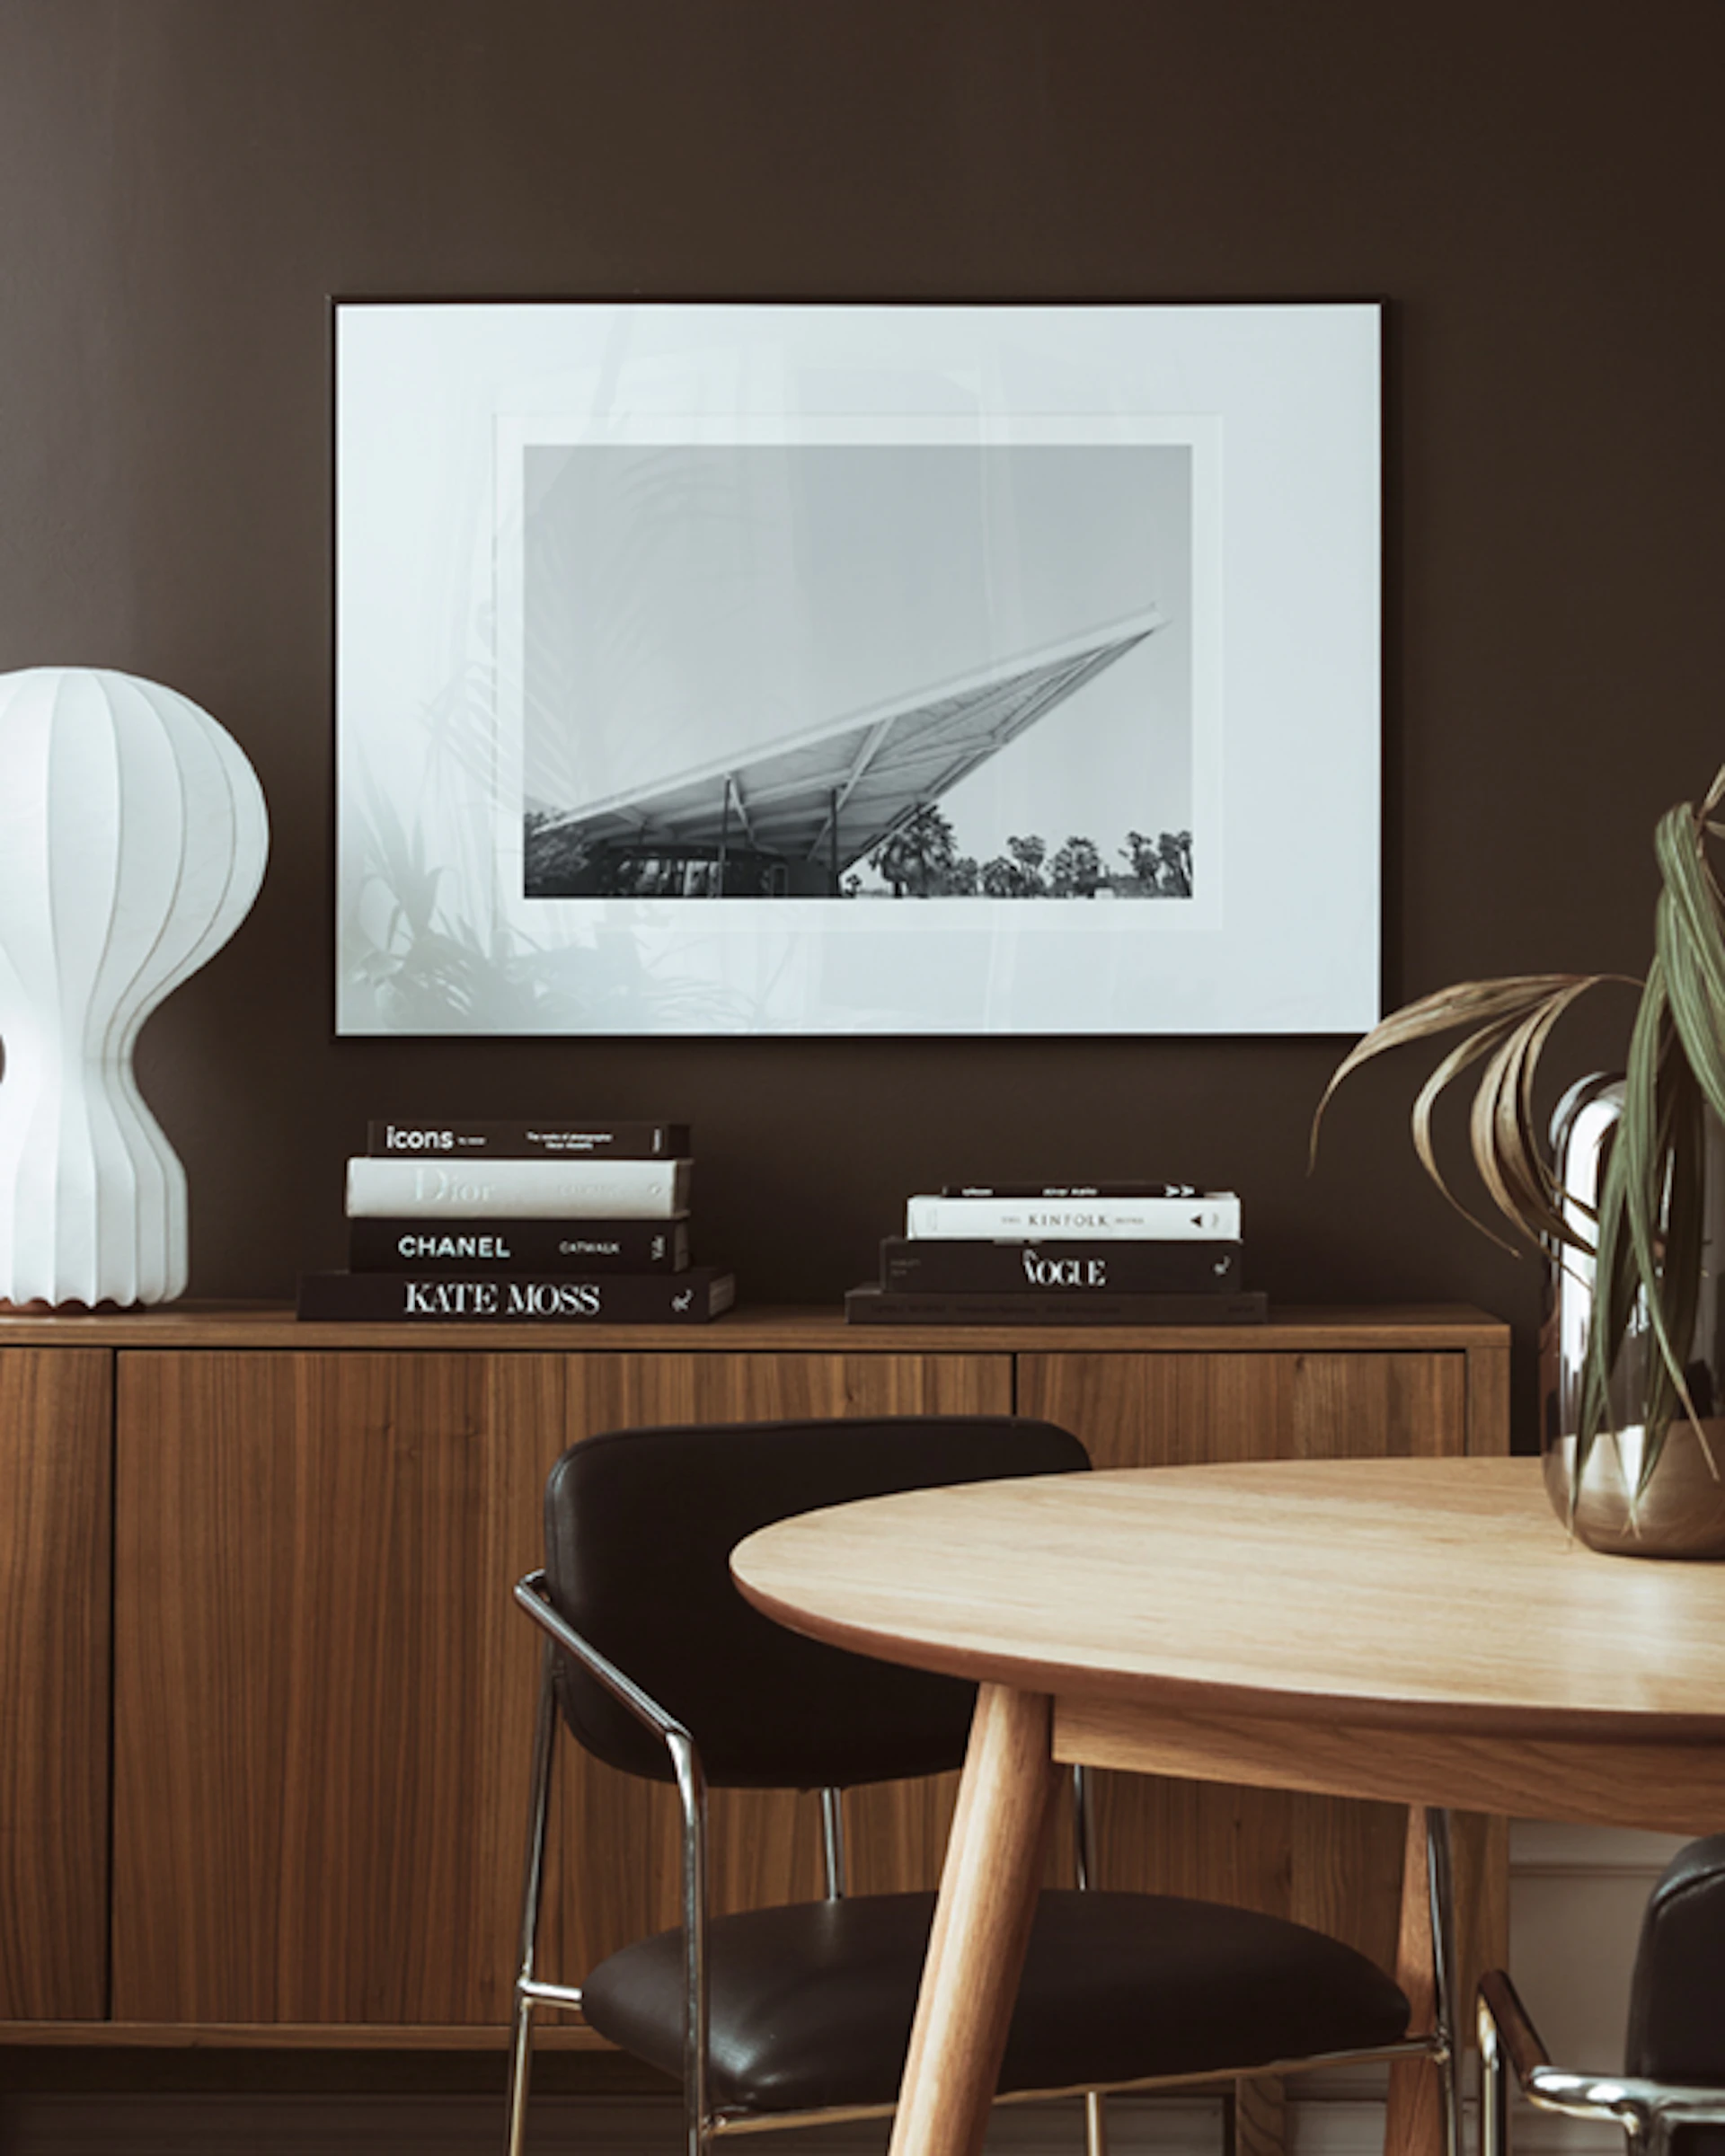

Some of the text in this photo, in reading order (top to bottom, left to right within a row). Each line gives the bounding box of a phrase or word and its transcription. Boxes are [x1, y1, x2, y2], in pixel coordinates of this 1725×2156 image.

[387, 1125, 454, 1150] icons
[414, 1167, 496, 1202] Dior
[1029, 1214, 1108, 1226] KINFOLK
[398, 1235, 511, 1259] CHANEL
[1023, 1254, 1106, 1286] VOGUE
[405, 1283, 601, 1315] KATE MOSS
